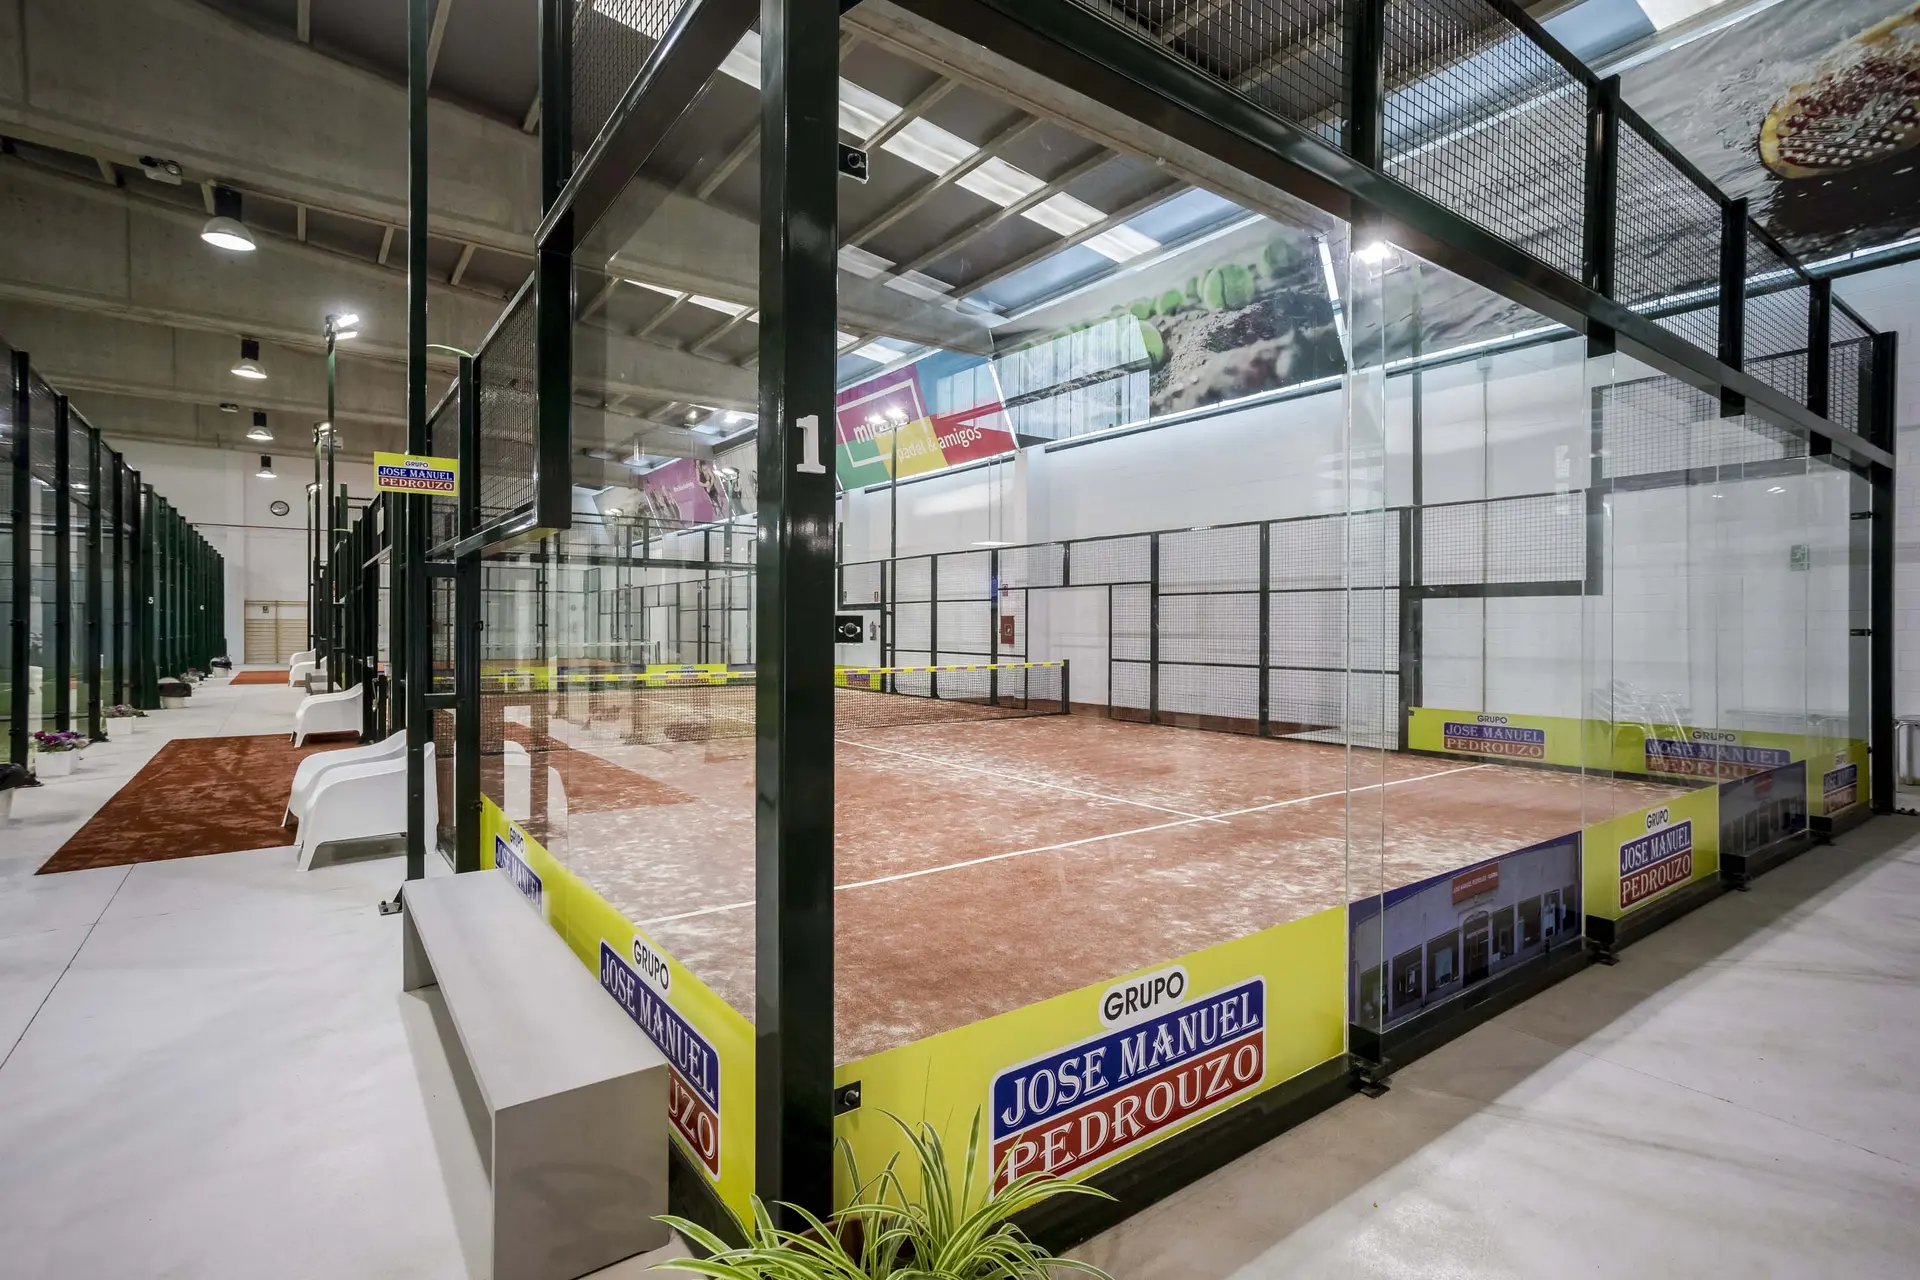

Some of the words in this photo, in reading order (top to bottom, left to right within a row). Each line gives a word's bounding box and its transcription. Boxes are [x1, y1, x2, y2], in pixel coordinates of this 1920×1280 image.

[796, 414, 826, 474] 1
[926, 435, 937, 452] &
[937, 427, 982, 449] amigos
[380, 467, 407, 477] JOSE
[409, 470, 453, 481] MANUEL
[405, 460, 429, 468] GRUPO
[380, 477, 453, 490] PEDROUZO
[148, 596, 154, 604] 5
[1476, 714, 1508, 724] GRUPO
[1446, 724, 1479, 737] JOSE
[1482, 727, 1542, 743] MANUEL
[1692, 730, 1736, 743] GRUPO
[1447, 738, 1542, 758] PEDROUZO
[1699, 744, 1787, 765] MANUEL
[1646, 808, 1669, 829] GRUPO
[1621, 841, 1649, 872] JOSE
[1650, 826, 1691, 860] MANUEL
[1622, 854, 1691, 904] PEDROUZO
[633, 939, 670, 991] GRUPO
[1103, 971, 1185, 1021] GRUPO
[602, 952, 637, 1019] JOSE
[639, 986, 717, 1105] MANUEL
[1001, 1045, 1109, 1128] JOSE
[1117, 991, 1260, 1083] MANUEL
[1000, 1043, 1260, 1188] PEDROUZO
